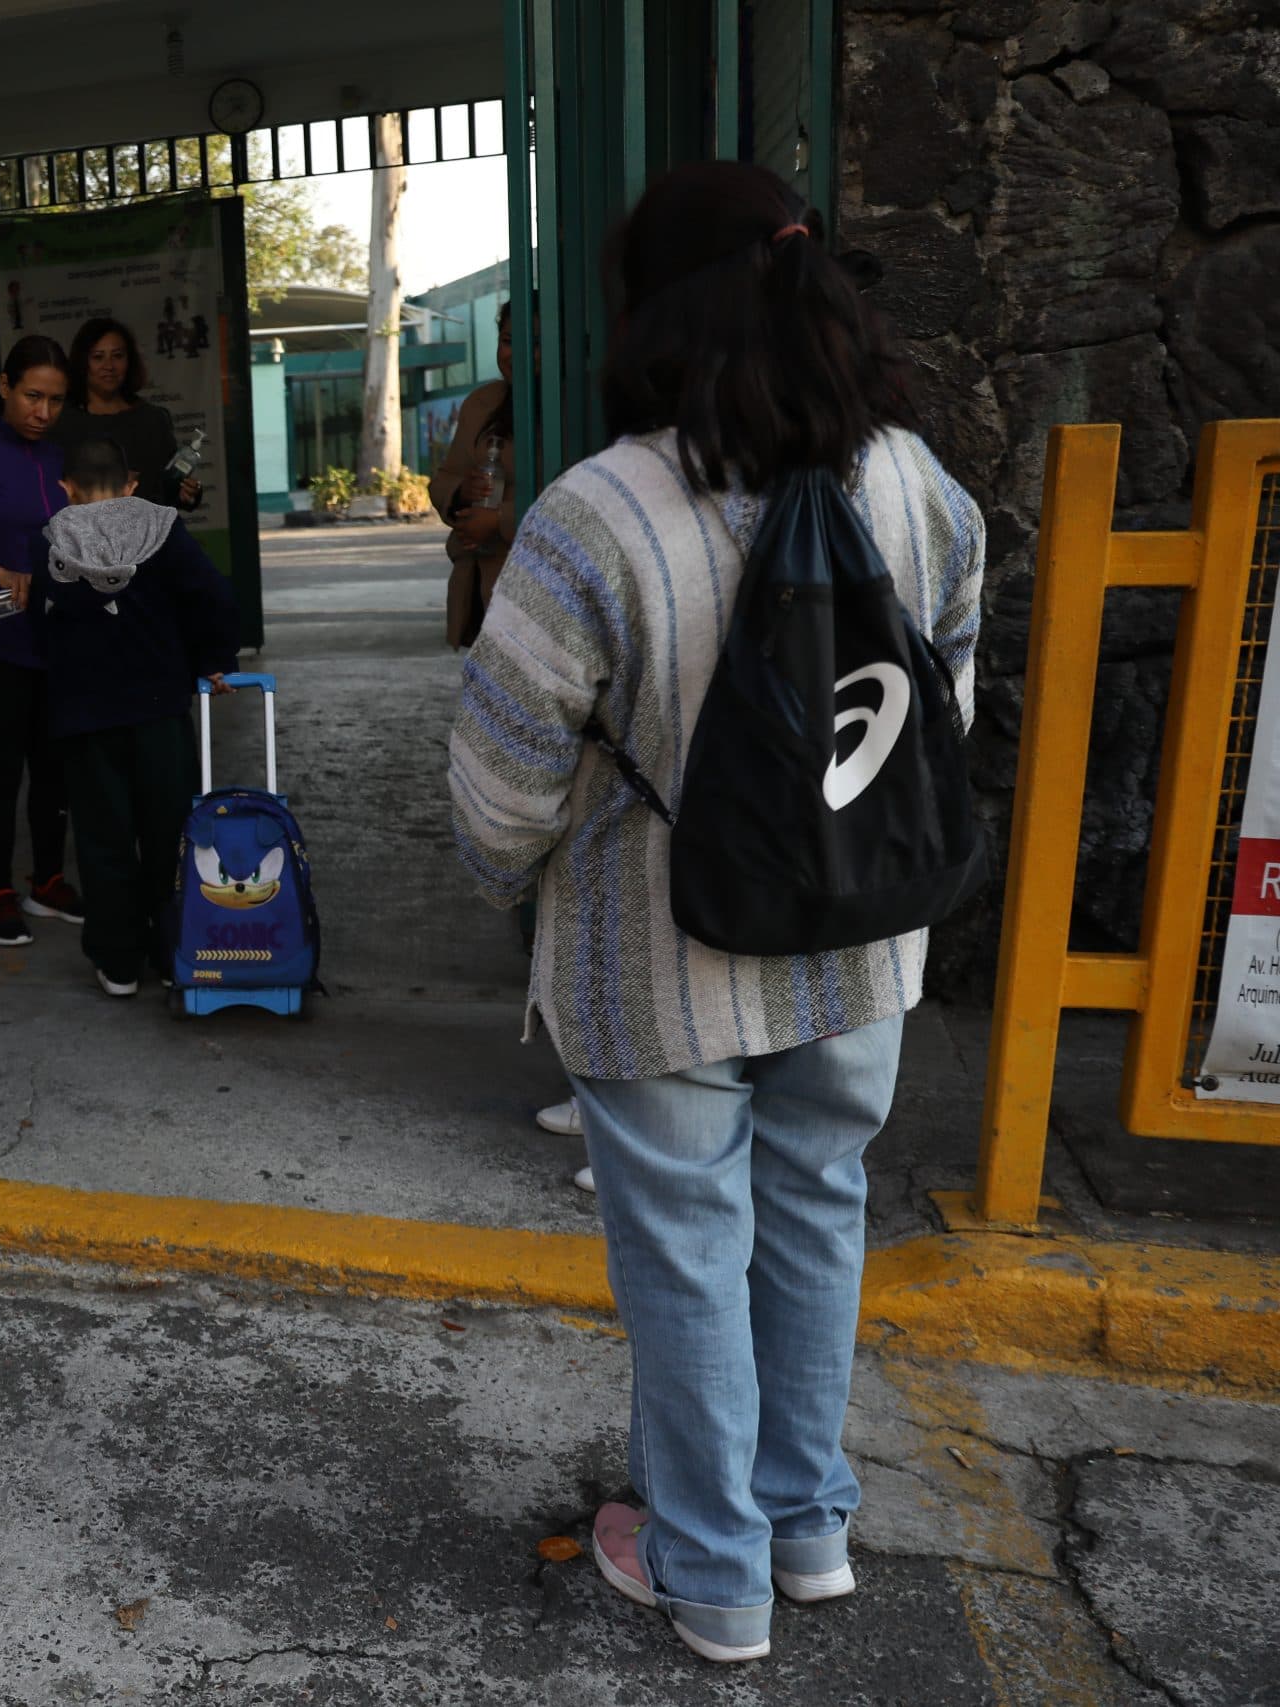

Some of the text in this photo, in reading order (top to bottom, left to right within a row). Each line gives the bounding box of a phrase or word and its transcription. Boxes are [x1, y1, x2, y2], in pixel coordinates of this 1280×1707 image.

[206, 921, 285, 950] SONIC
[192, 969, 223, 979] SONIC
[1248, 954, 1266, 975] Av.
